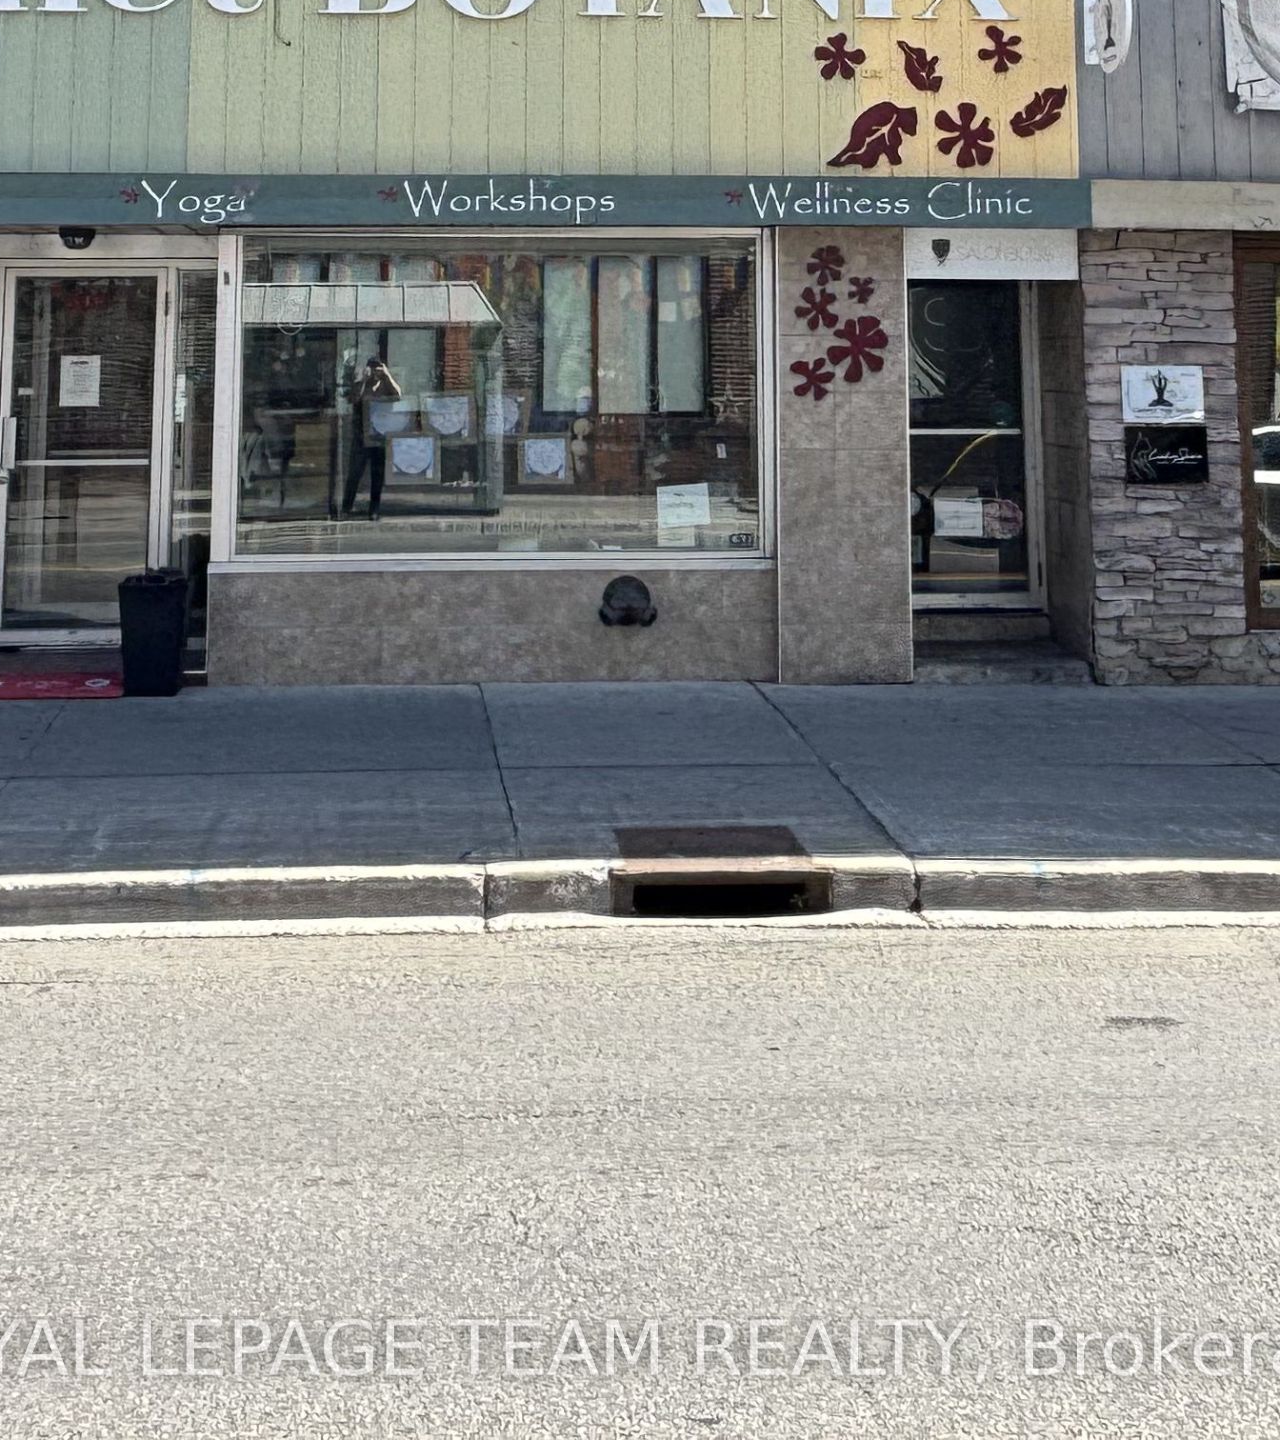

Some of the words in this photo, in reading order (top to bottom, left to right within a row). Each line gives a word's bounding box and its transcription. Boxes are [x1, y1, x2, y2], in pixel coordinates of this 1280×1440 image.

[140, 179, 247, 225] Yoga
[402, 178, 616, 224] Workshops
[748, 181, 911, 219] Wellness
[927, 181, 1033, 220] Clinic
